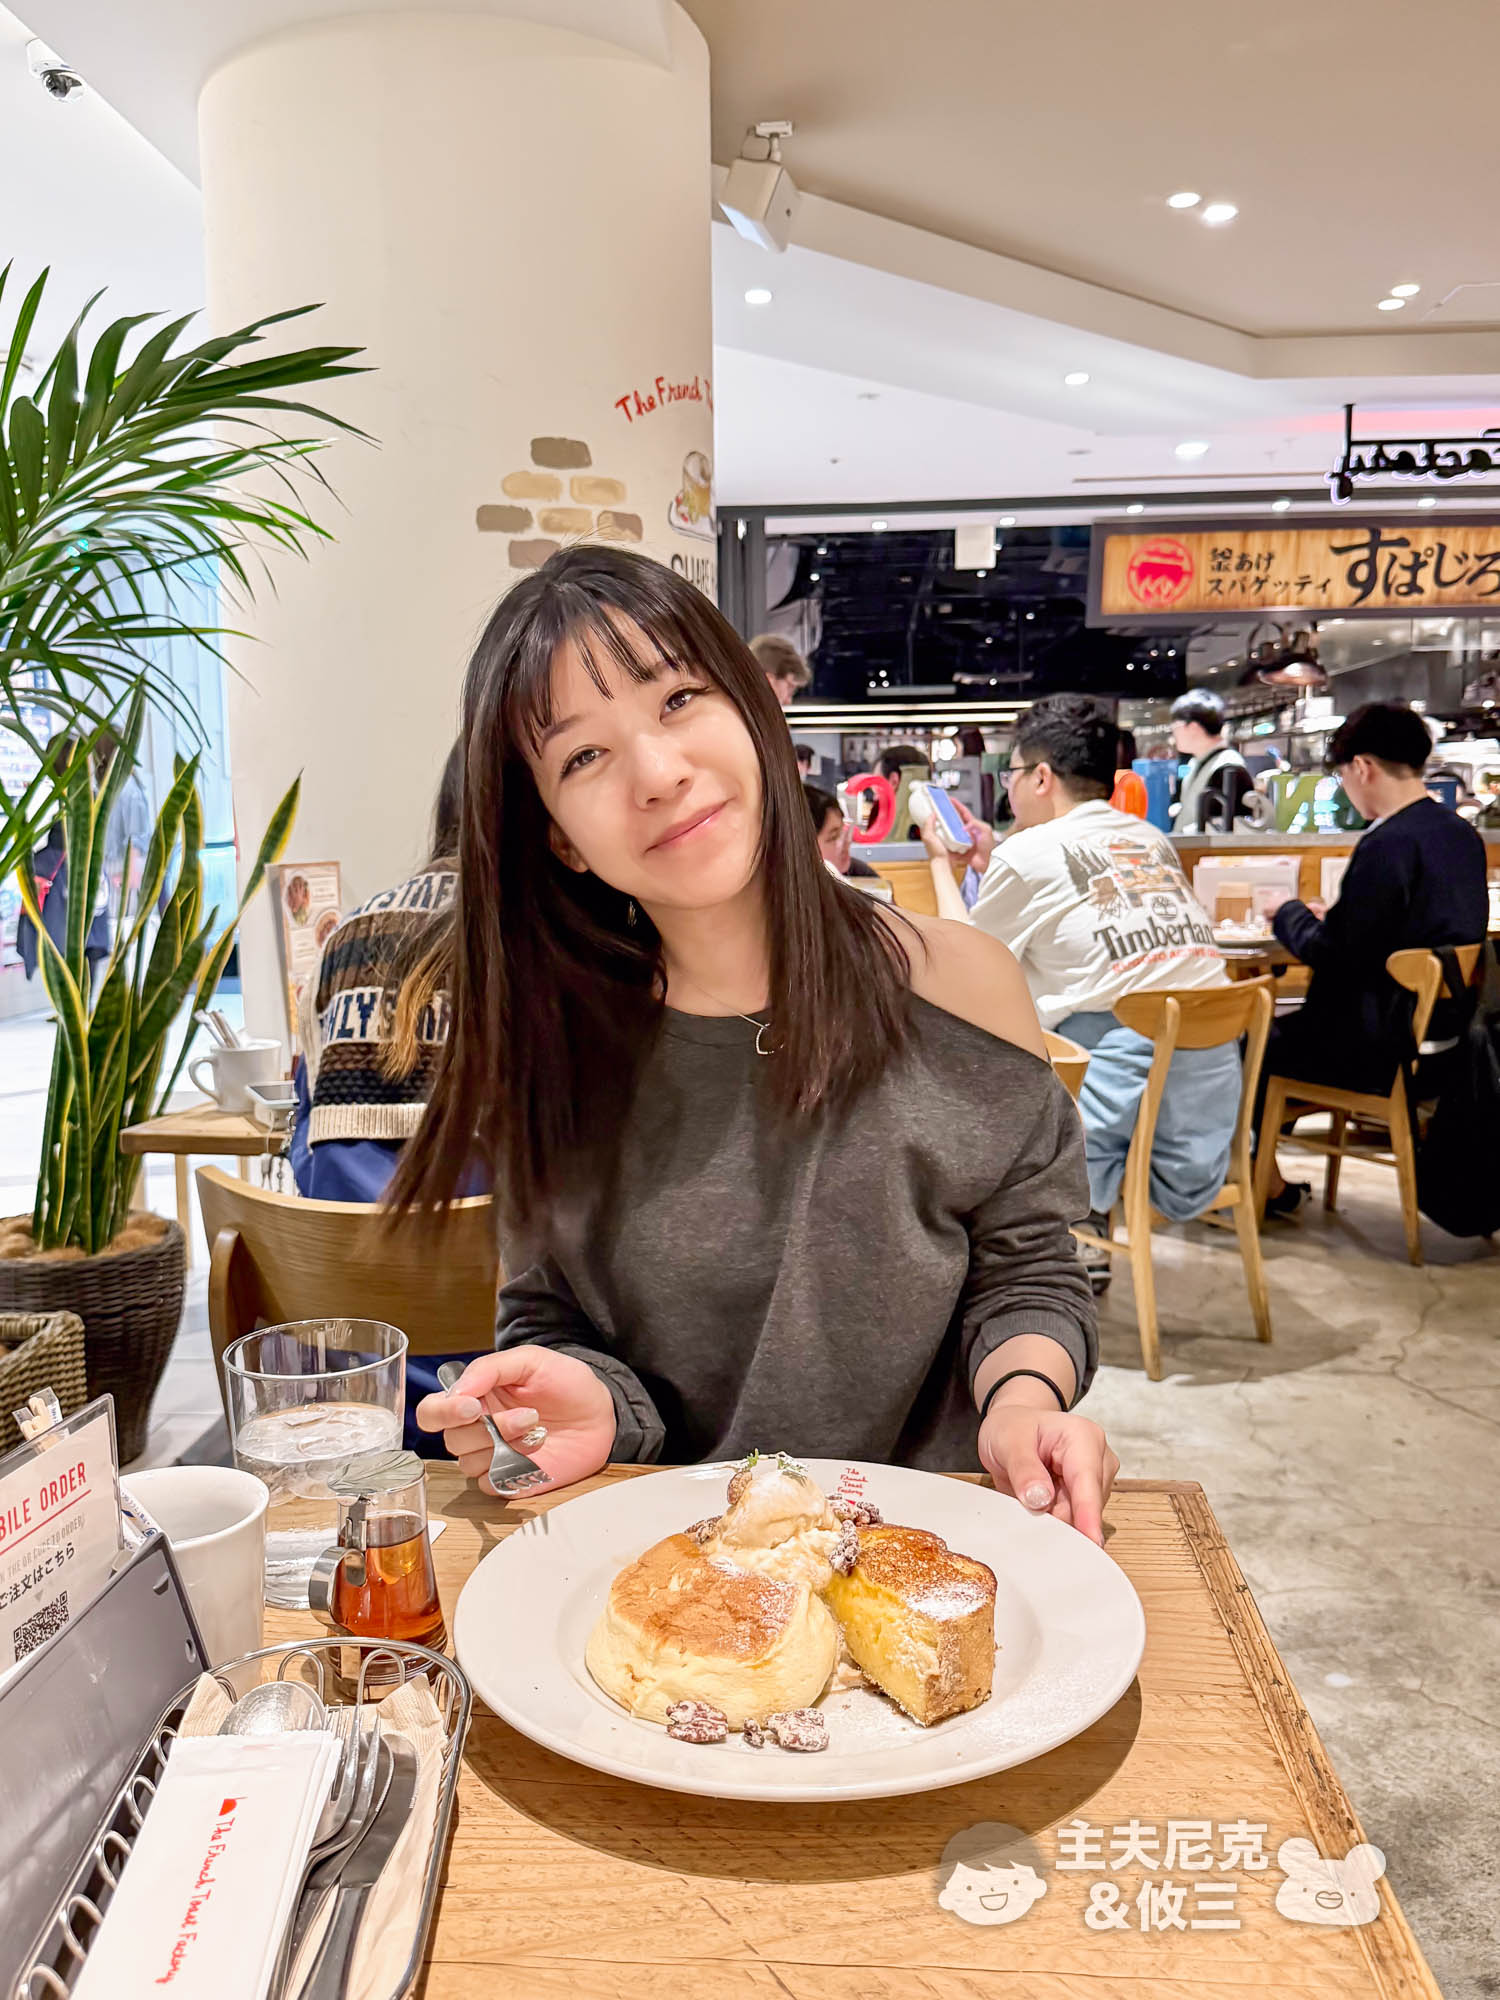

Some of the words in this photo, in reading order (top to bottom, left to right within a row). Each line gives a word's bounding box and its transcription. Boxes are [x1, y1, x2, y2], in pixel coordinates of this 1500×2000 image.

[614, 389, 657, 423] The
[39, 1460, 87, 1512] ORDER
[211, 1817, 236, 1842] The
